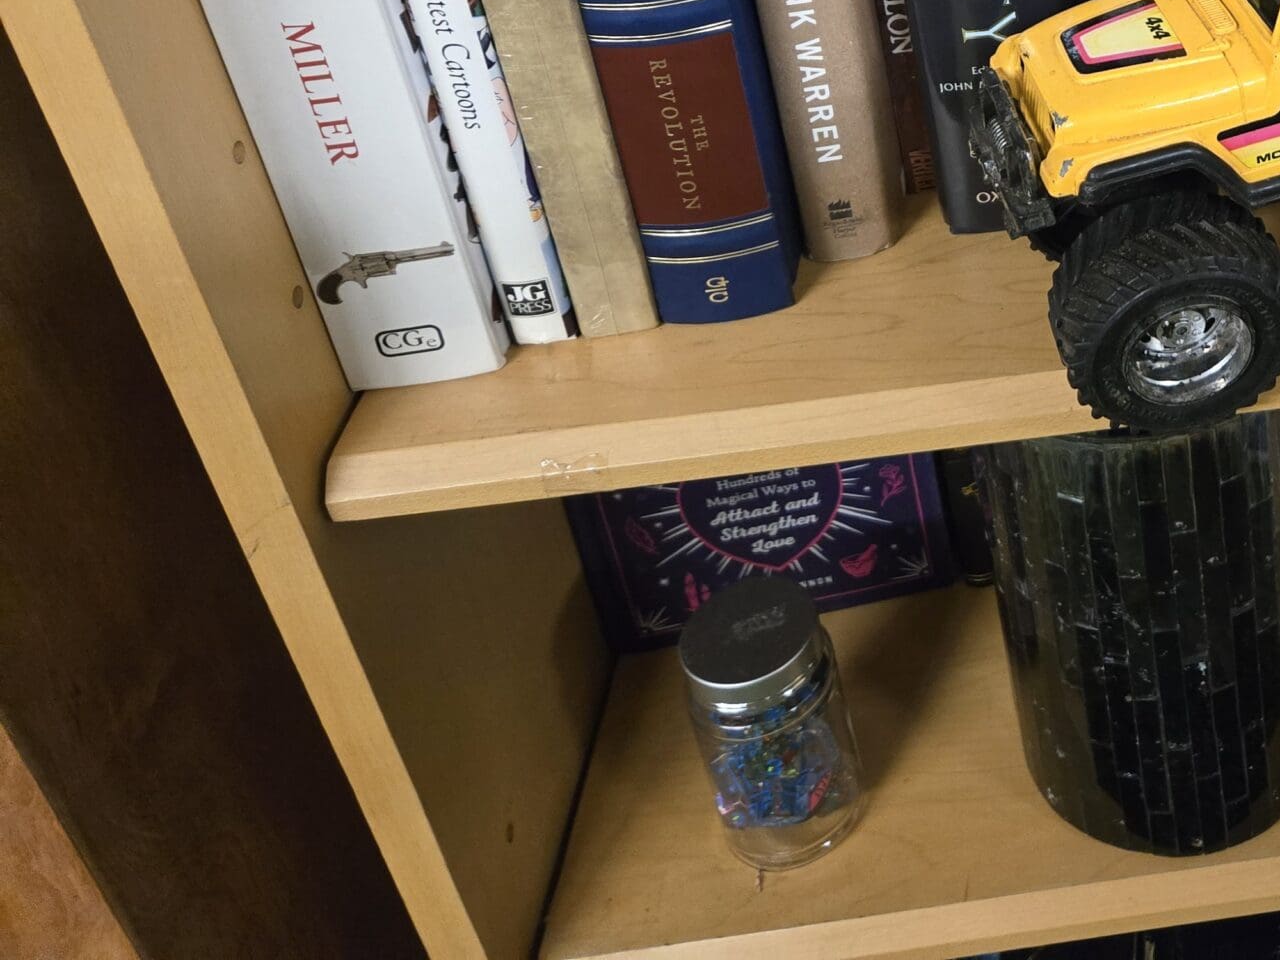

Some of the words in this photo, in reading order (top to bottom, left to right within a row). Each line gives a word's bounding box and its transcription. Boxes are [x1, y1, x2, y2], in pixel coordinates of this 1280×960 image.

[1144, 16, 1172, 41] 4x4
[281, 21, 359, 166] MILLER
[441, 43, 481, 130] Cartoons
[939, 82, 973, 93] JOHN
[795, 38, 843, 164] WARREN
[649, 58, 702, 210] REVOLUTION
[690, 115, 709, 152] THE
[507, 283, 547, 302] JG
[510, 299, 552, 314] PRESS
[705, 487, 759, 507] Magical
[761, 483, 799, 496] Ways
[801, 479, 817, 488] to
[710, 500, 781, 526] Attract
[784, 491, 821, 511] and
[719, 513, 819, 541] Strengthen
[751, 536, 796, 553] Love
